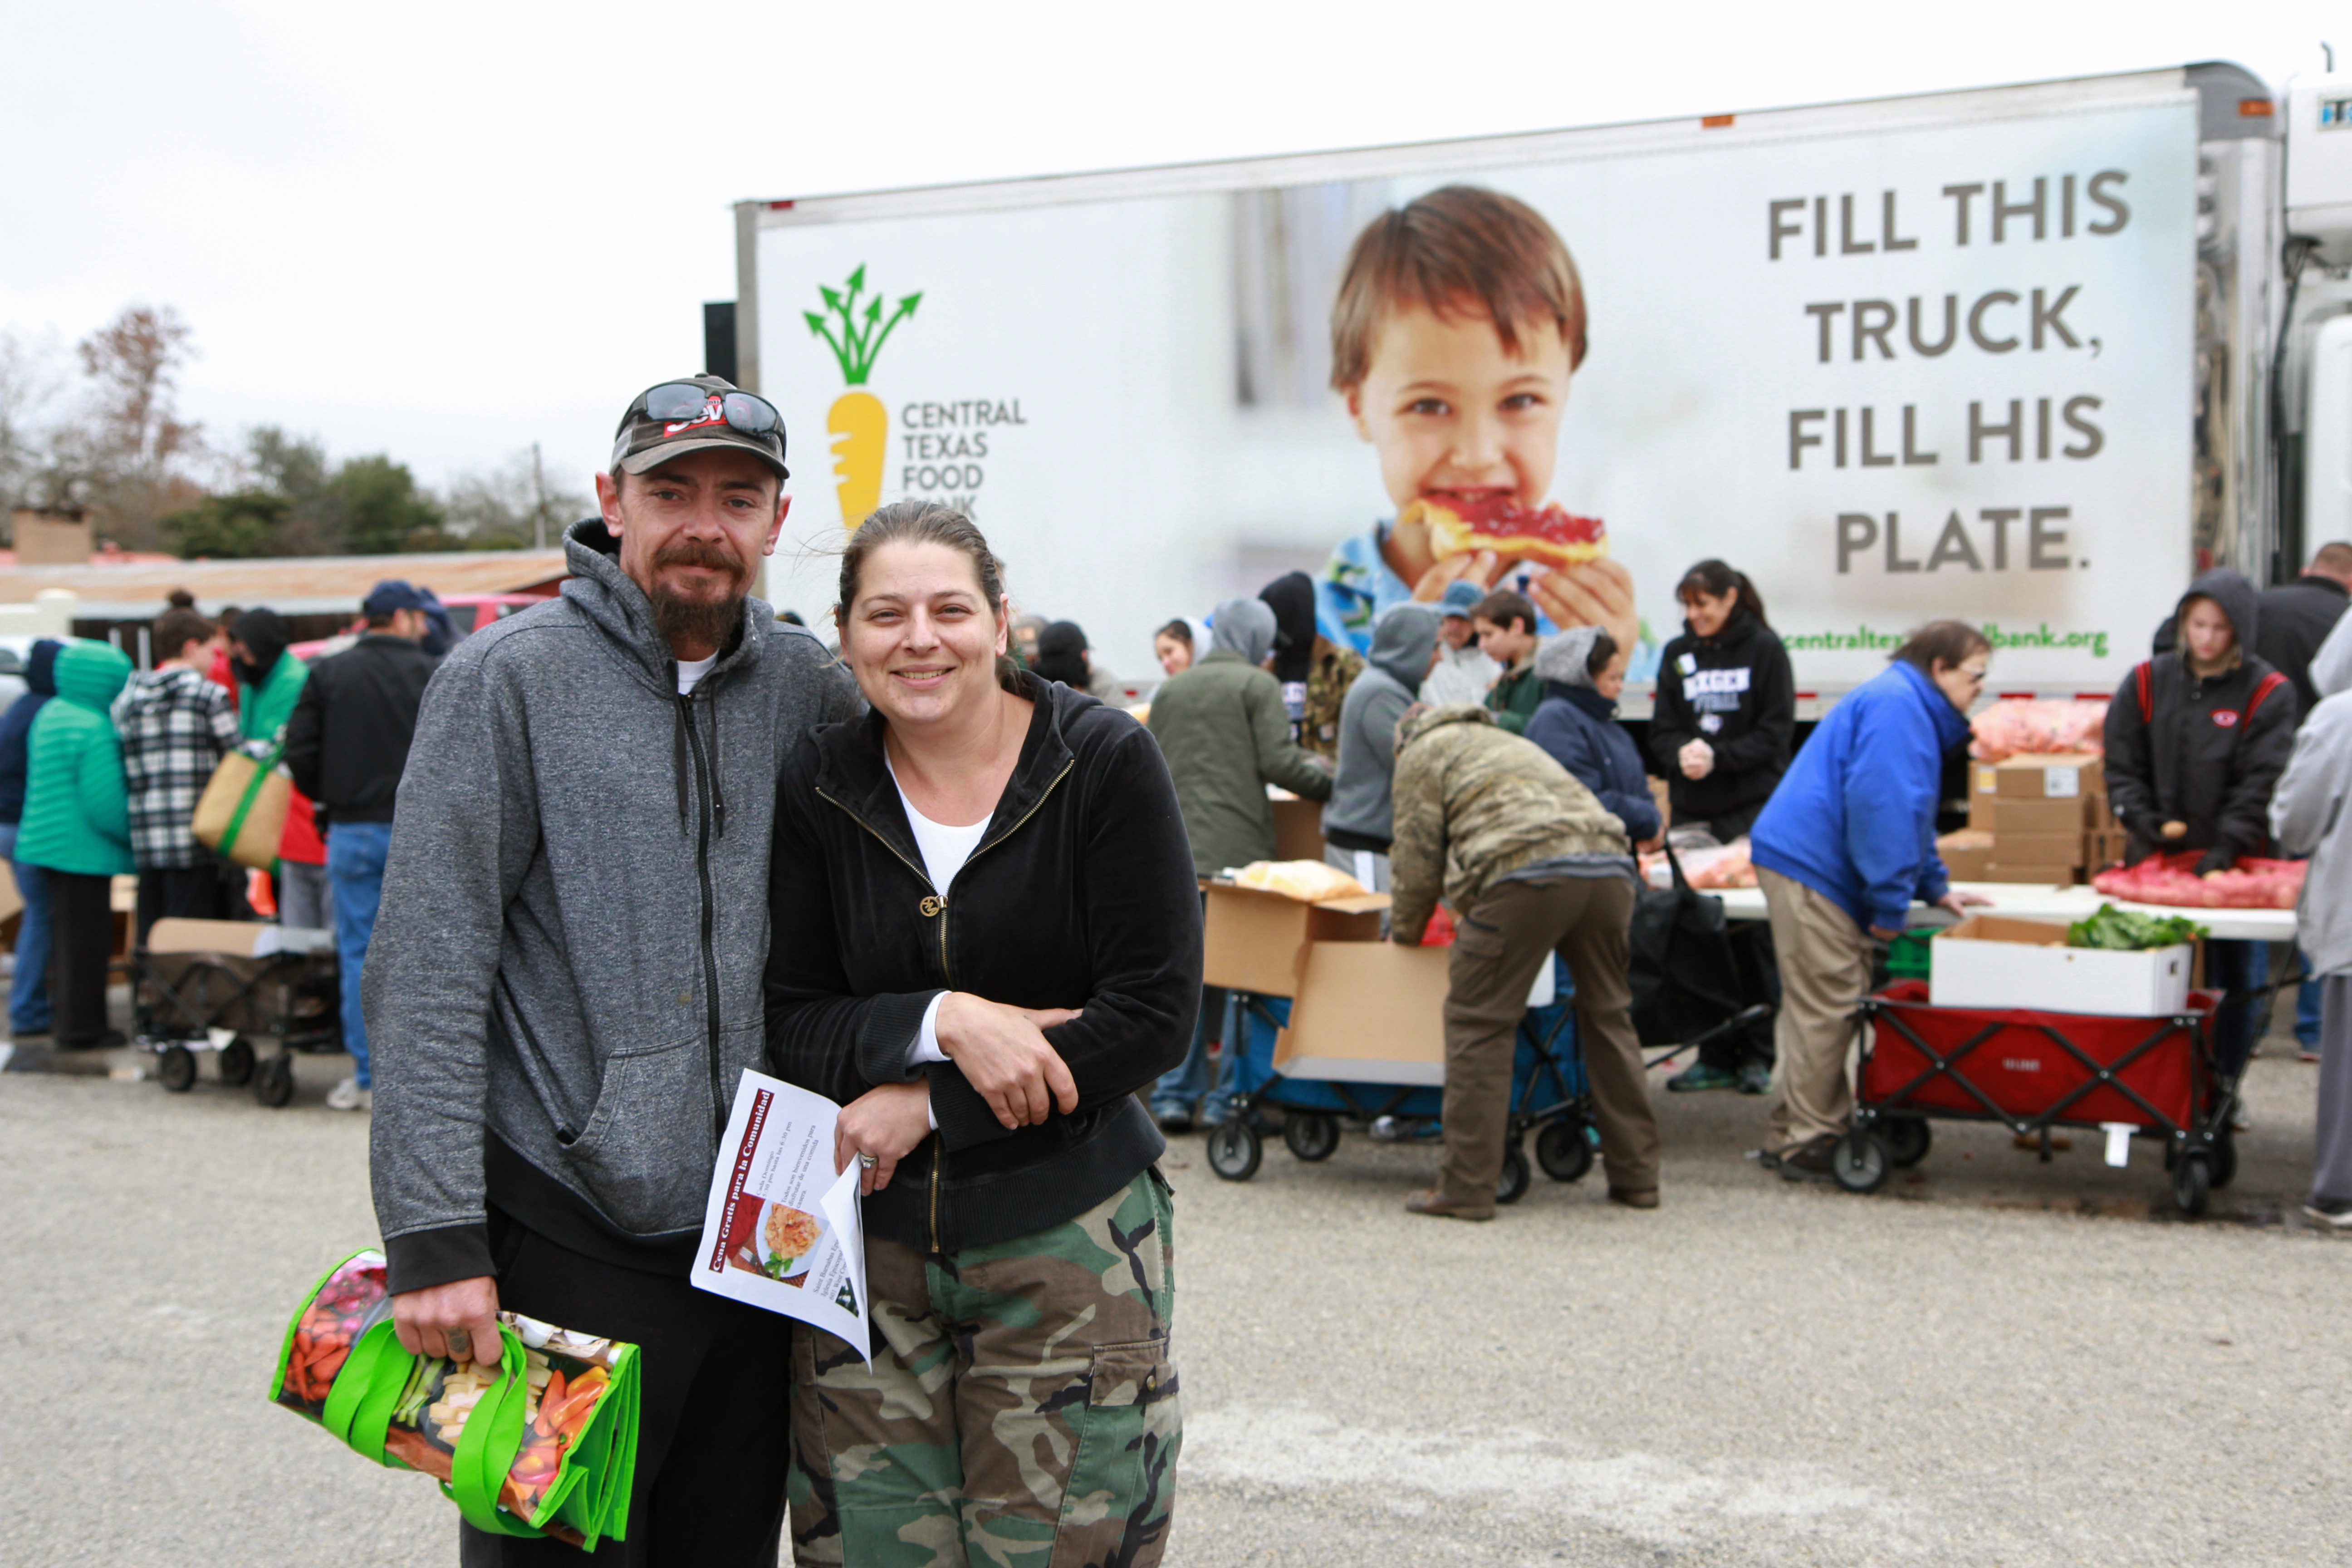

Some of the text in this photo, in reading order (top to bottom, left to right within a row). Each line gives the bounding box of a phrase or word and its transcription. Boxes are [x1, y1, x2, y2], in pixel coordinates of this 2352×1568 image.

[1769, 168, 2131, 260] FILL THIS
[1805, 284, 2102, 363] TRUCK,
[902, 399, 1027, 428] CENTRAL
[1789, 394, 2105, 470] FILL HIS
[902, 431, 988, 459] TEXAS
[903, 464, 983, 490] FOOD
[1836, 506, 2091, 573] PLATE.
[786, 1122, 792, 1132] pm
[713, 1091, 770, 1271] Cena Gratis para la Comunidad
[757, 1151, 774, 1196] Cada Domingo
[768, 1173, 774, 1183] pm
[770, 1156, 779, 1172] hasta
[781, 1186, 791, 1202] Todos
[792, 1139, 810, 1173] bienvenidos
[808, 1125, 816, 1138] para
[789, 1181, 801, 1206] disfrutar
[808, 1140, 819, 1161] comida
[797, 1191, 807, 1209] casera.
[813, 1279, 823, 1293] Saint
[819, 1252, 834, 1278] Barnabas
[820, 1278, 833, 1297] Iglesia
